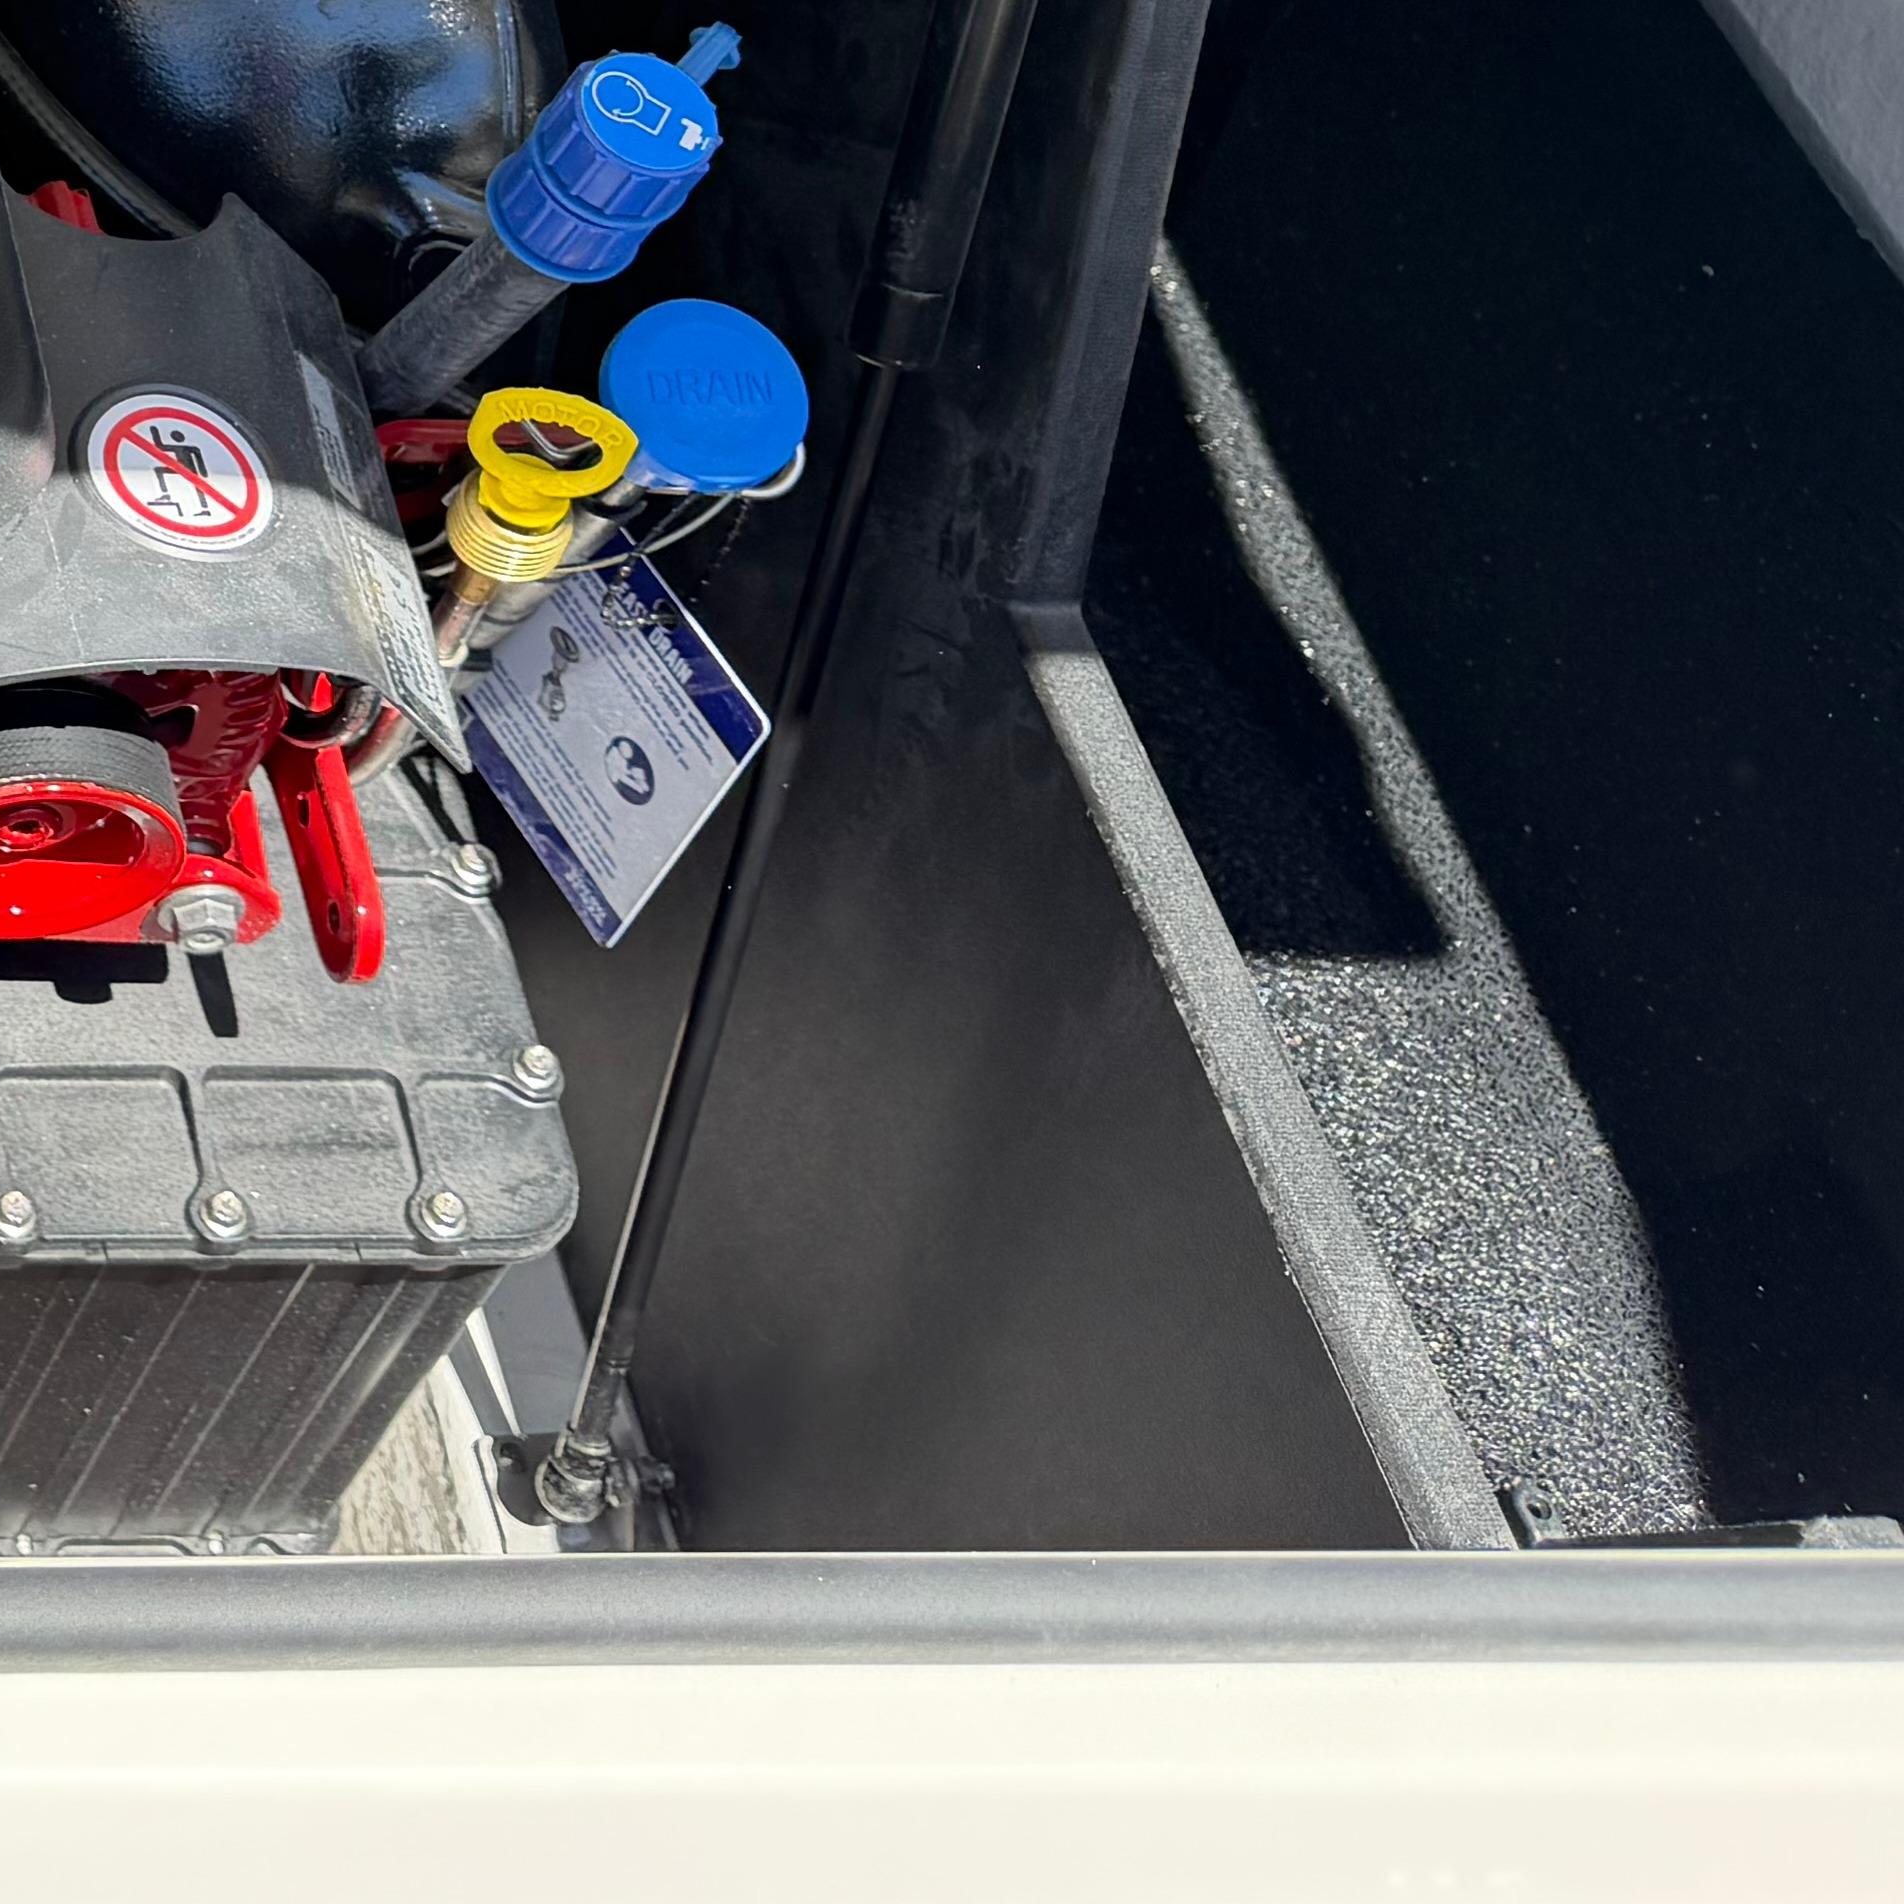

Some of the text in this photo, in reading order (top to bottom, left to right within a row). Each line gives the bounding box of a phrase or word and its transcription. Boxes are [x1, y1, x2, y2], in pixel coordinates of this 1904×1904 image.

[647, 368, 774, 405] DRAIN
[497, 399, 625, 452] MOTOR
[612, 579, 651, 629] EAS
[646, 623, 695, 686] DRAIN
